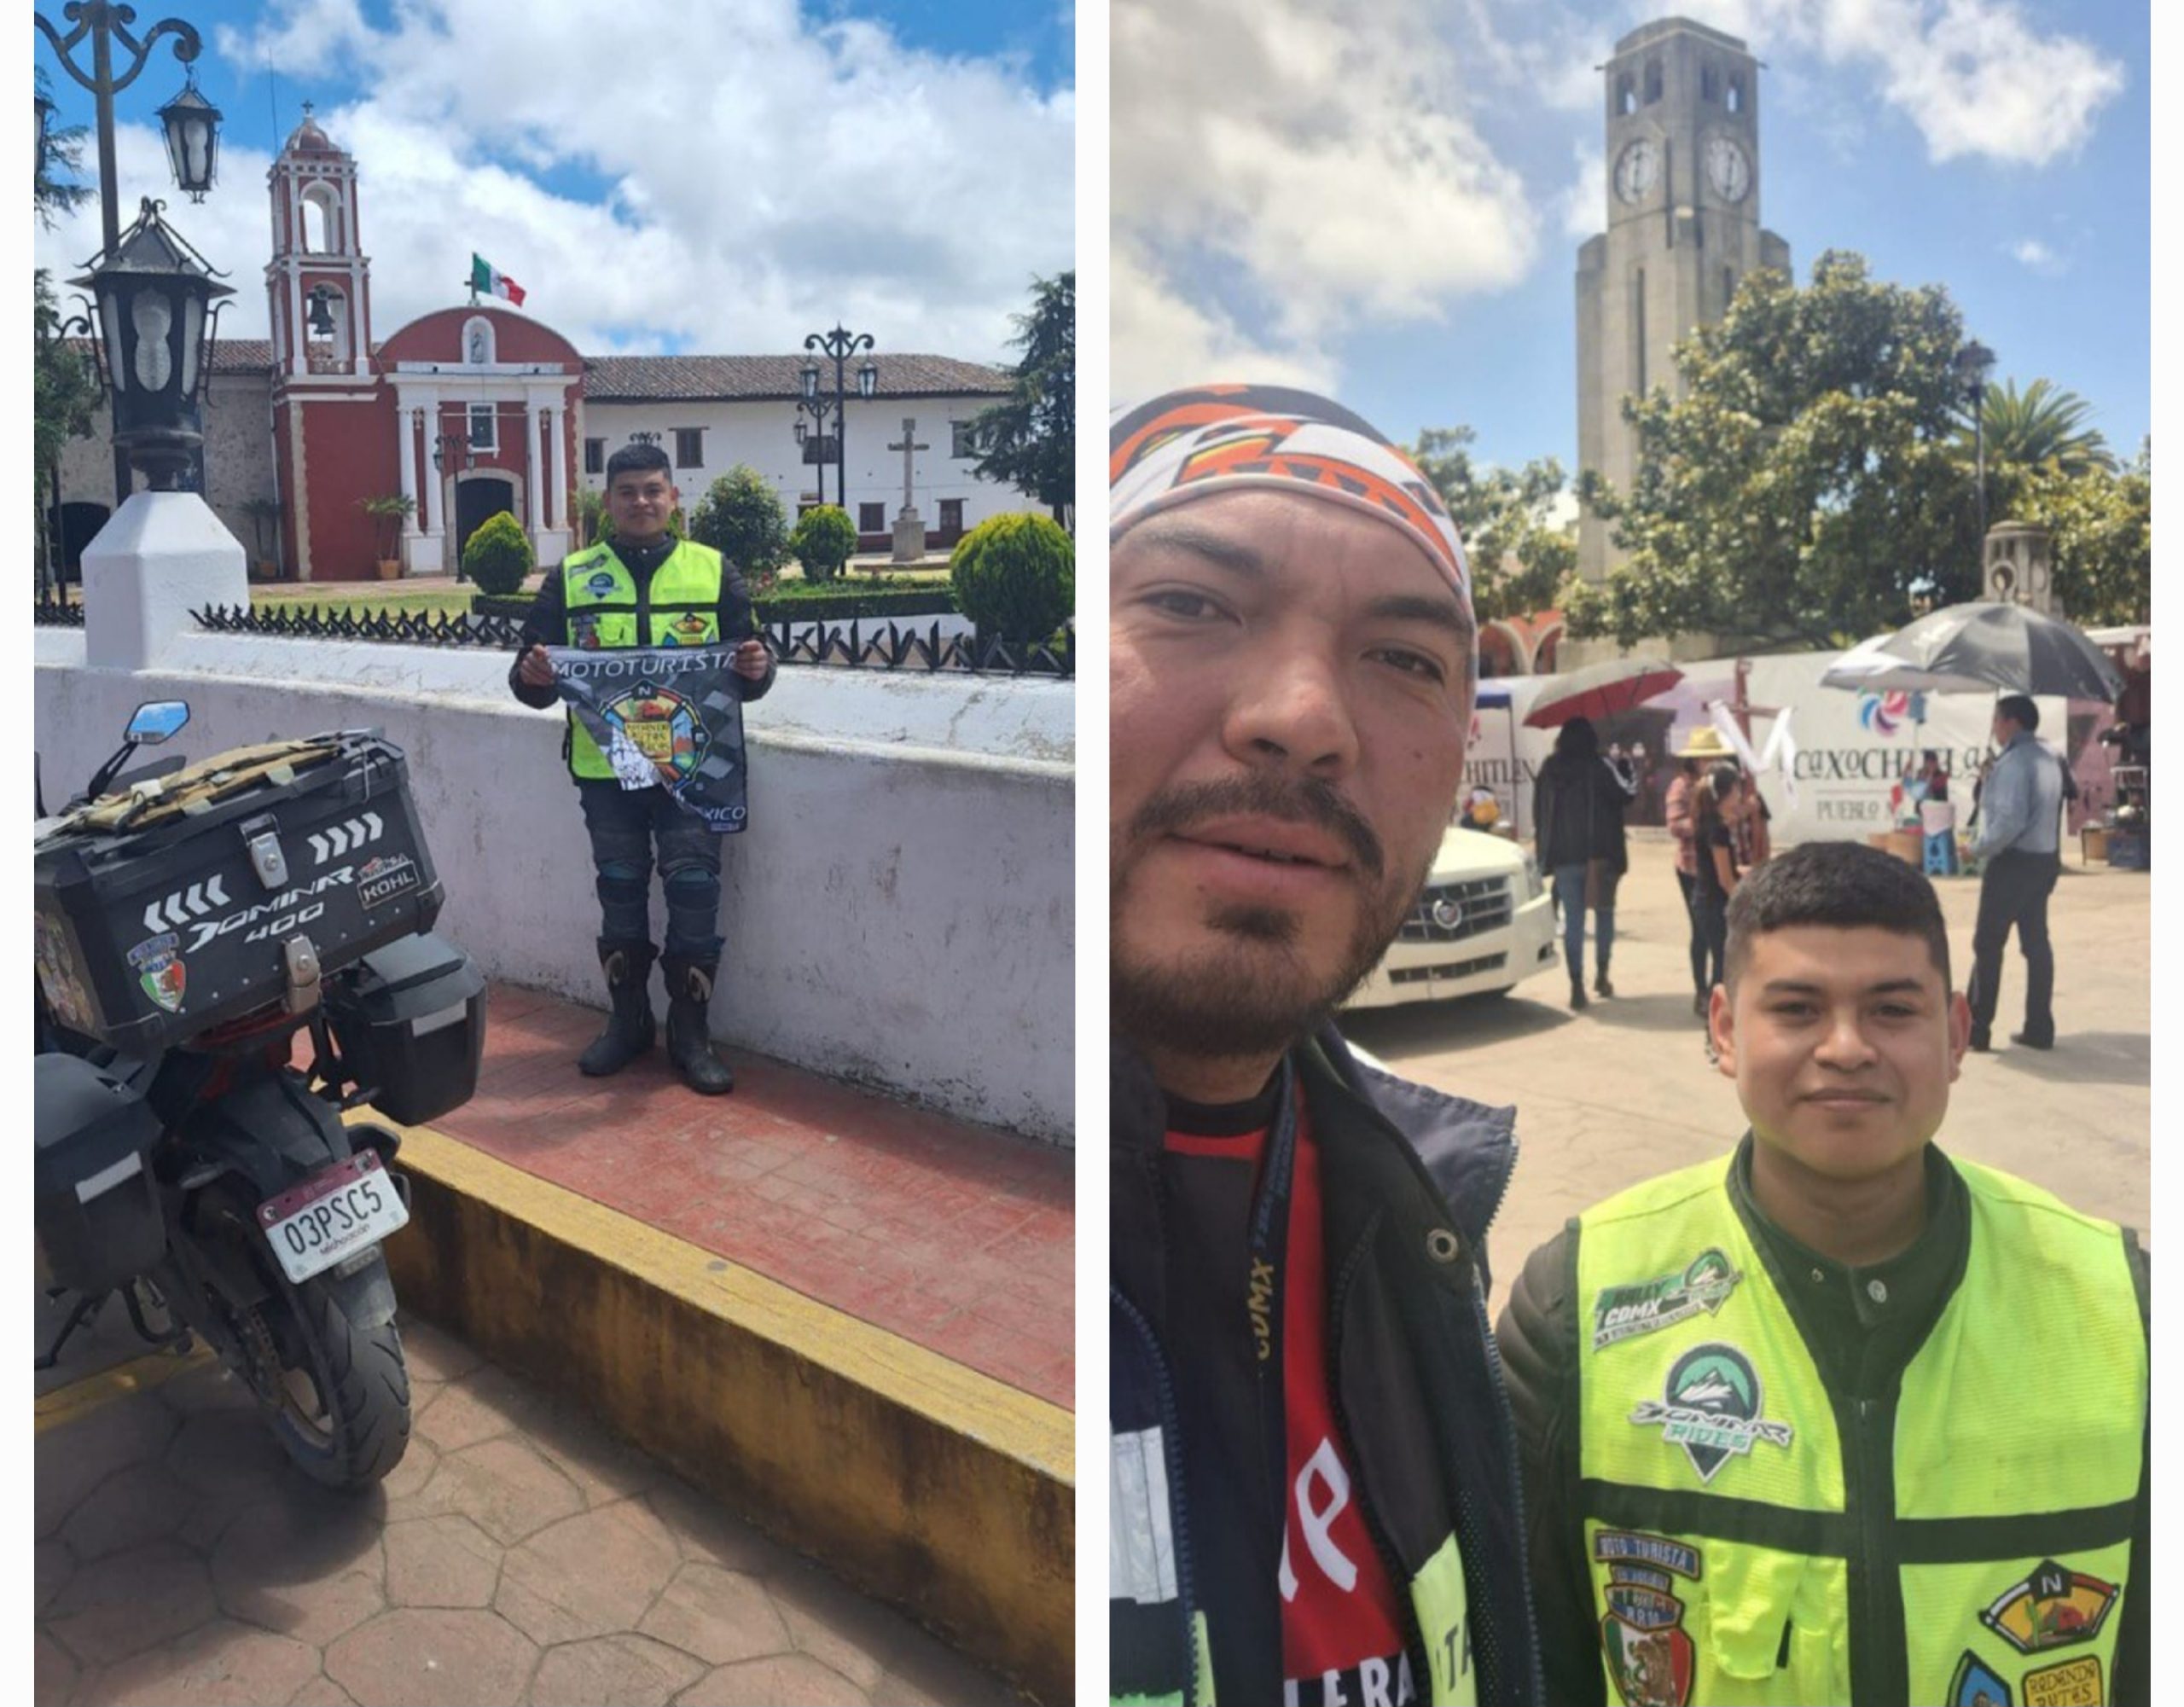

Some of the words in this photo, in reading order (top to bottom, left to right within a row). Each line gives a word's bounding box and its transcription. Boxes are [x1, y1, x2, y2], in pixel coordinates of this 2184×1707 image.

[363, 871, 415, 903] KOHL
[185, 865, 355, 954] DOMINAR
[244, 902, 324, 943] 400
[283, 1180, 382, 1255] 03PSC5
[1604, 1297, 1663, 1327] CDMX
[1670, 1423, 1748, 1449] RIDES
[1634, 1538, 1687, 1568] TURISTA
[2041, 1574, 2062, 1594] N
